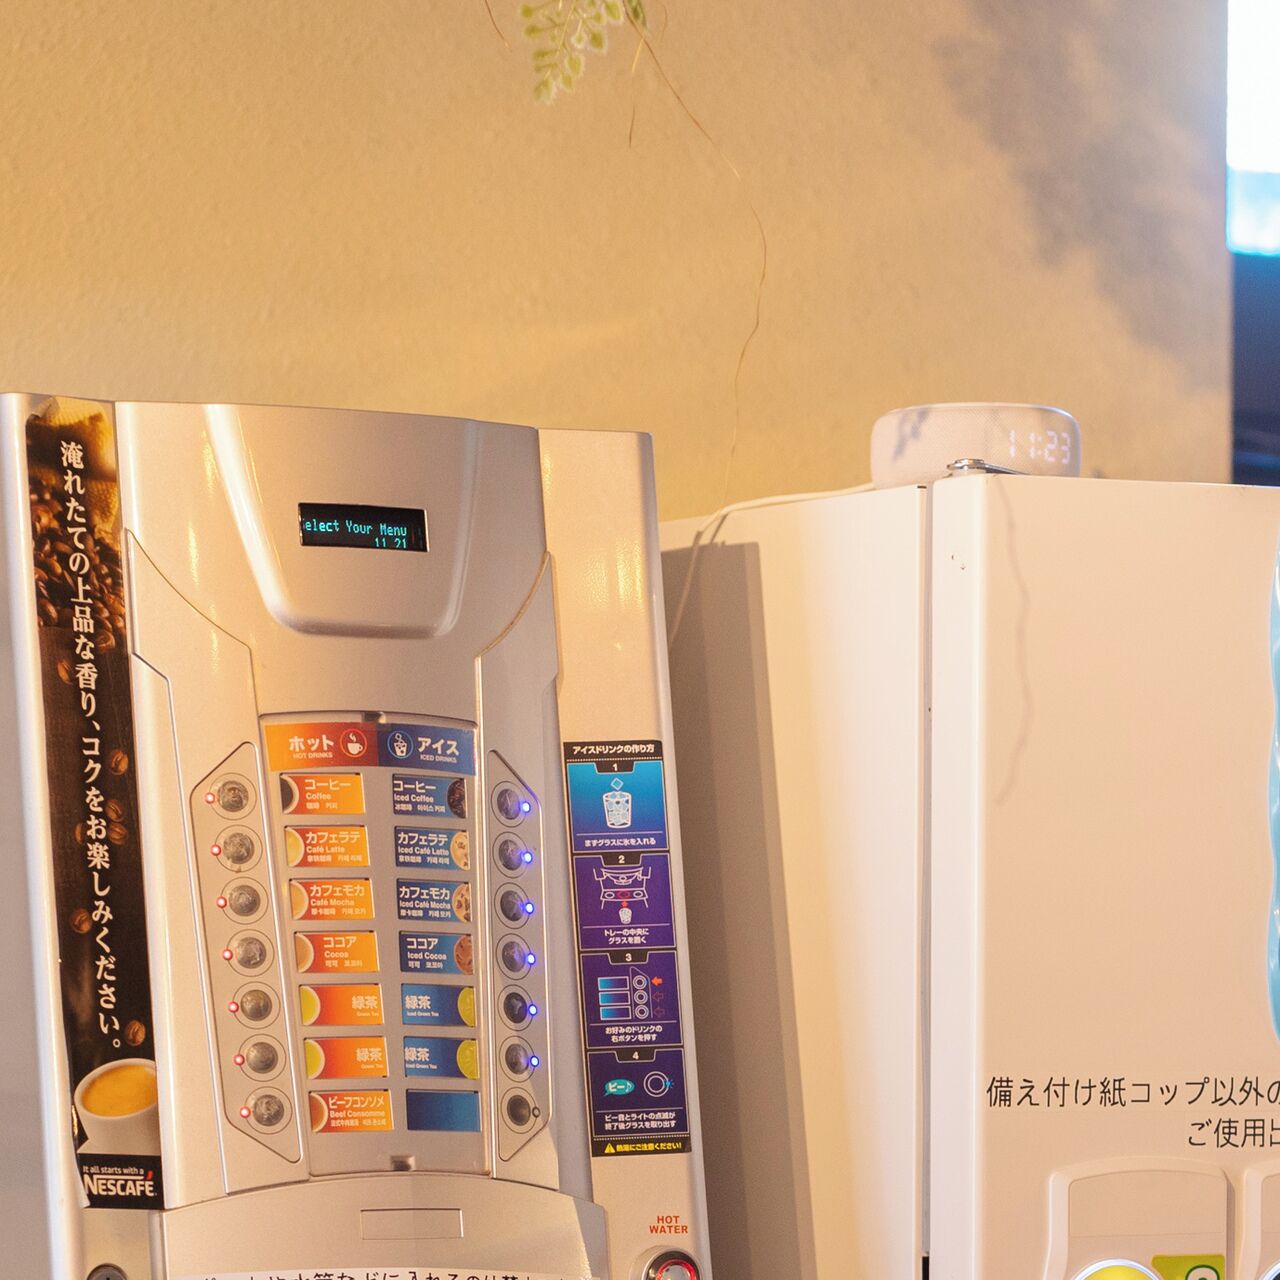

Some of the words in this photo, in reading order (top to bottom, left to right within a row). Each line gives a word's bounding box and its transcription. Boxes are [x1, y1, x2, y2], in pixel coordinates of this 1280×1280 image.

[1009, 430, 1070, 464] 11:23
[302, 518, 340, 532] elect
[345, 520, 374, 535] Your
[380, 523, 407, 536] Menu
[61, 440, 120, 1049] 淹れたての上品な香り、コクをお楽しみください。
[289, 733, 334, 751] ホット
[418, 737, 460, 756] アイス
[572, 744, 655, 755] アイスドリンクの作り方
[293, 752, 307, 760] HOT
[420, 754, 434, 762] ICED
[436, 756, 457, 764] DRINKS
[612, 763, 619, 771] 1
[305, 779, 352, 791] コーヒー
[394, 780, 436, 792] コーヒー
[306, 792, 332, 800] Coffee
[394, 793, 409, 802] Iced
[410, 794, 434, 803] Coffee
[306, 832, 360, 844] カフェラテ
[398, 832, 448, 846] カフェラテ
[584, 838, 656, 848] まずグラスに氷を入れる
[398, 846, 413, 854] Iced
[618, 855, 625, 864] 2
[310, 884, 365, 897] カフェモカ
[400, 886, 450, 900] カフェモカ
[400, 900, 413, 908] Iced
[323, 936, 357, 948] ココア
[406, 938, 438, 950] ココア
[408, 951, 423, 959] Iced
[424, 952, 447, 961] Cocoa
[352, 996, 378, 1009] 緑茶
[405, 995, 431, 1009] 緑茶
[605, 1025, 662, 1034] お好みのドリンクの
[356, 1048, 382, 1062] 緑茶
[404, 1047, 429, 1062] 緑茶
[633, 1052, 639, 1060] 4
[328, 1096, 384, 1109] ビーフコンソメ
[101, 1166, 122, 1174] starts
[83, 1170, 154, 1196] NESCAFÉ
[656, 1216, 680, 1225] HOT
[649, 1225, 688, 1234] WATER
